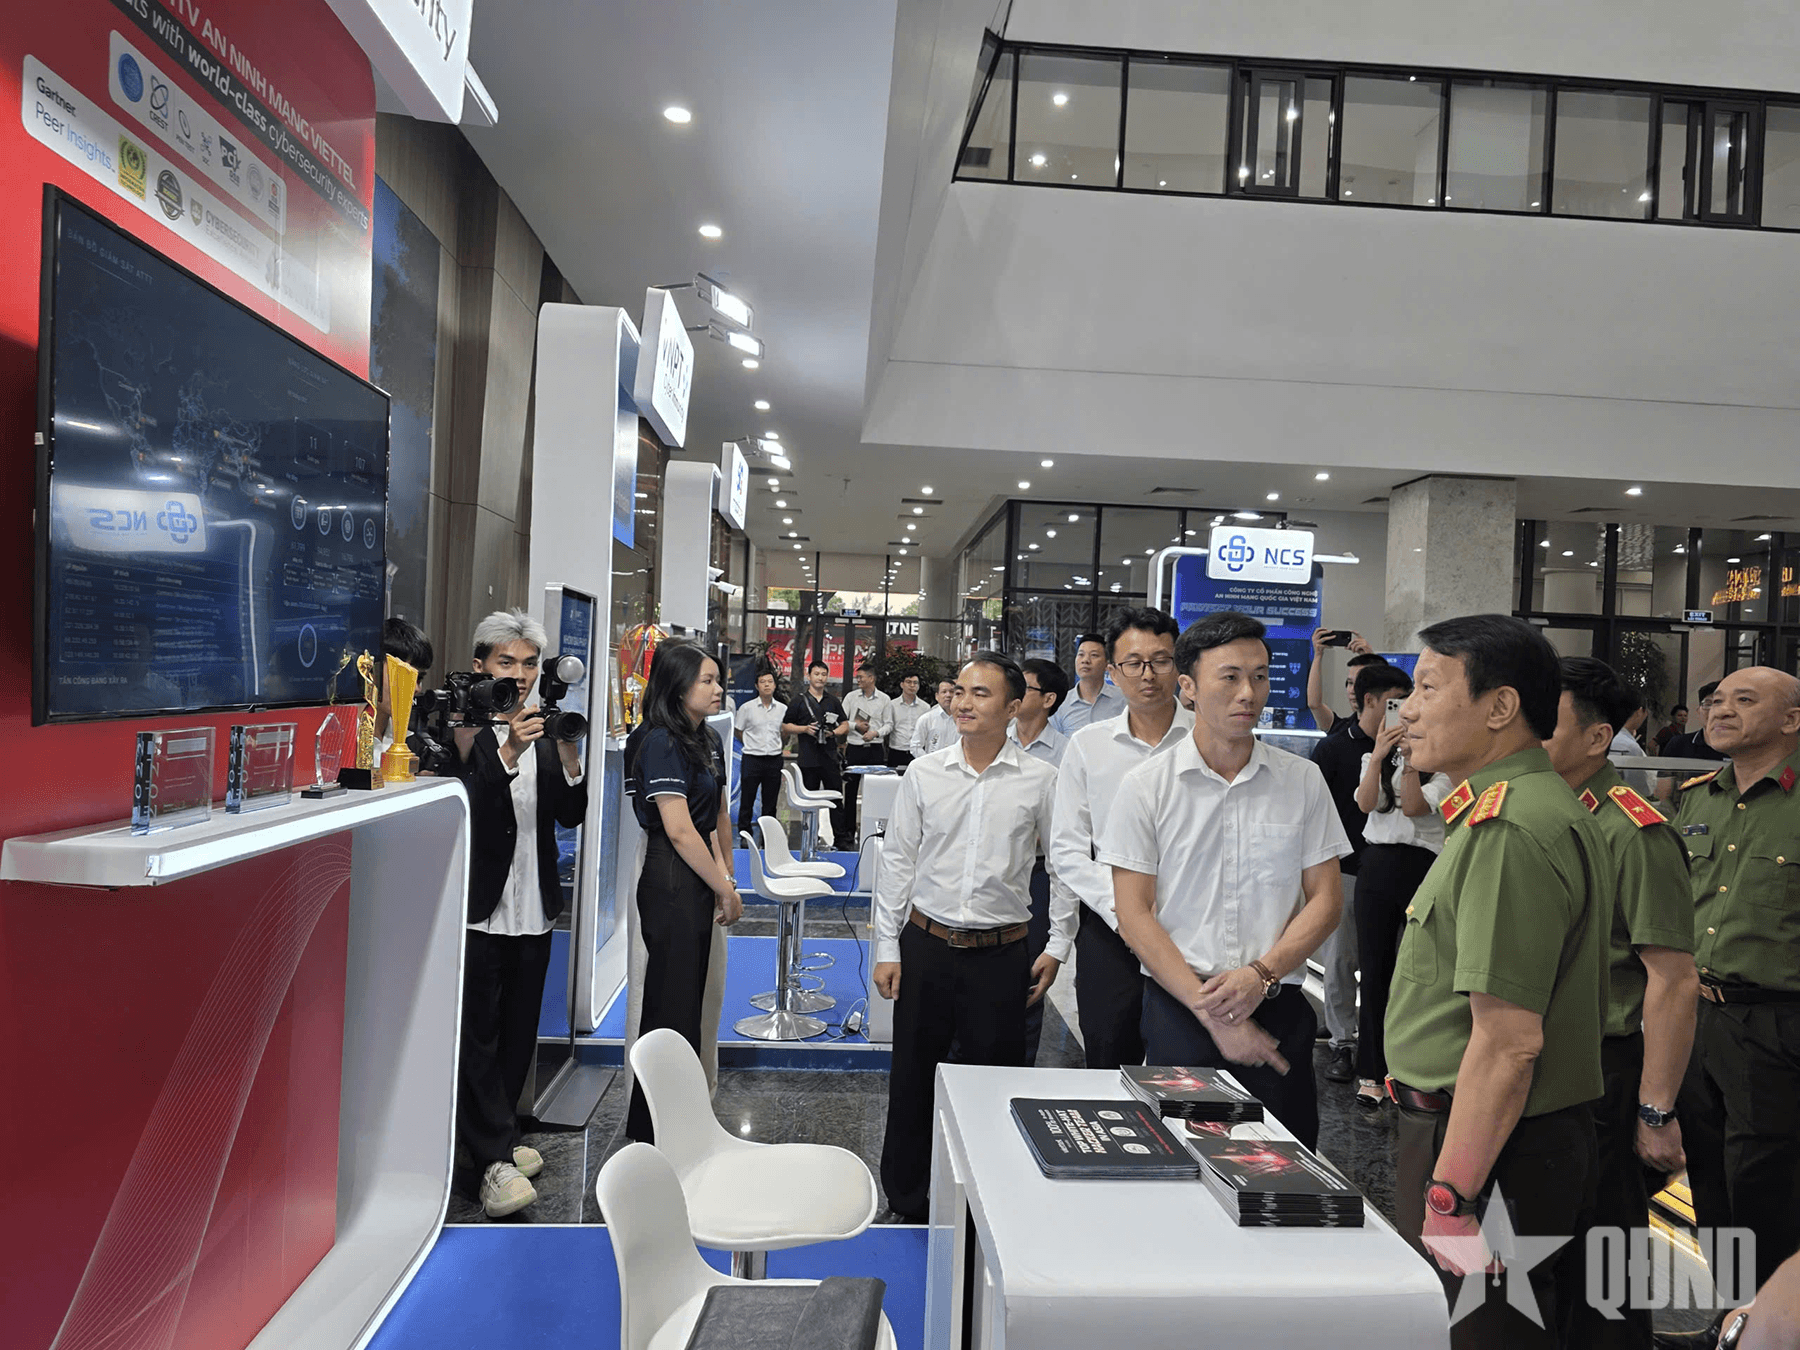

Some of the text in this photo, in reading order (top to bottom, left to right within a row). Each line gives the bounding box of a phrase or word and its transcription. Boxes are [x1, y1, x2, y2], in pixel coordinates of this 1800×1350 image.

[35, 101, 65, 135] Peer
[152, 10, 185, 54] with
[187, 45, 268, 132] world-class
[268, 124, 337, 200] cybersecurity
[336, 190, 369, 231] experts
[202, 18, 226, 58] AN
[229, 43, 267, 98] NINH
[310, 126, 357, 191] VIETTEL
[1264, 547, 1305, 566] NCS
[1266, 606, 1318, 618] SUCCESS
